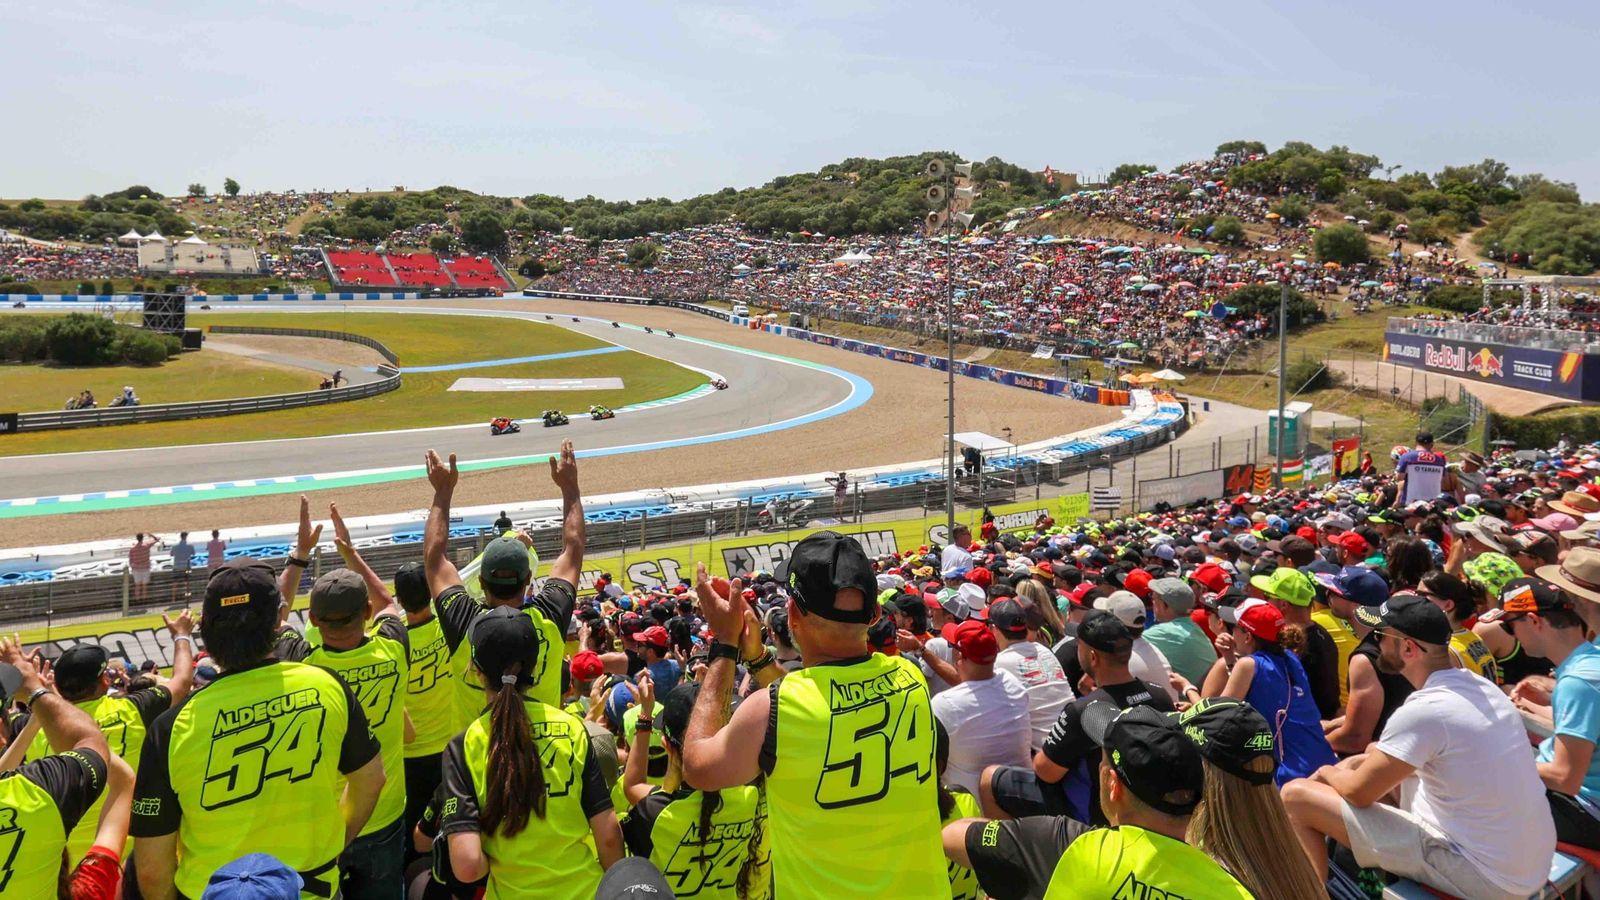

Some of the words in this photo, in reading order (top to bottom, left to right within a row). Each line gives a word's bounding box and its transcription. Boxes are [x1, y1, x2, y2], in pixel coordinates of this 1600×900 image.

[1513, 364, 1533, 375] TRACK
[1534, 368, 1552, 378] CLUB
[223, 596, 248, 605] PIRELLI
[411, 637, 447, 661] ALDEGU
[338, 659, 398, 684] DEGUER
[407, 645, 453, 694] 54
[830, 666, 920, 711] ALDEGUER
[211, 687, 321, 738] ALDEGUER
[200, 705, 326, 811] 54
[815, 684, 936, 810] 54
[1249, 733, 1273, 750] 46
